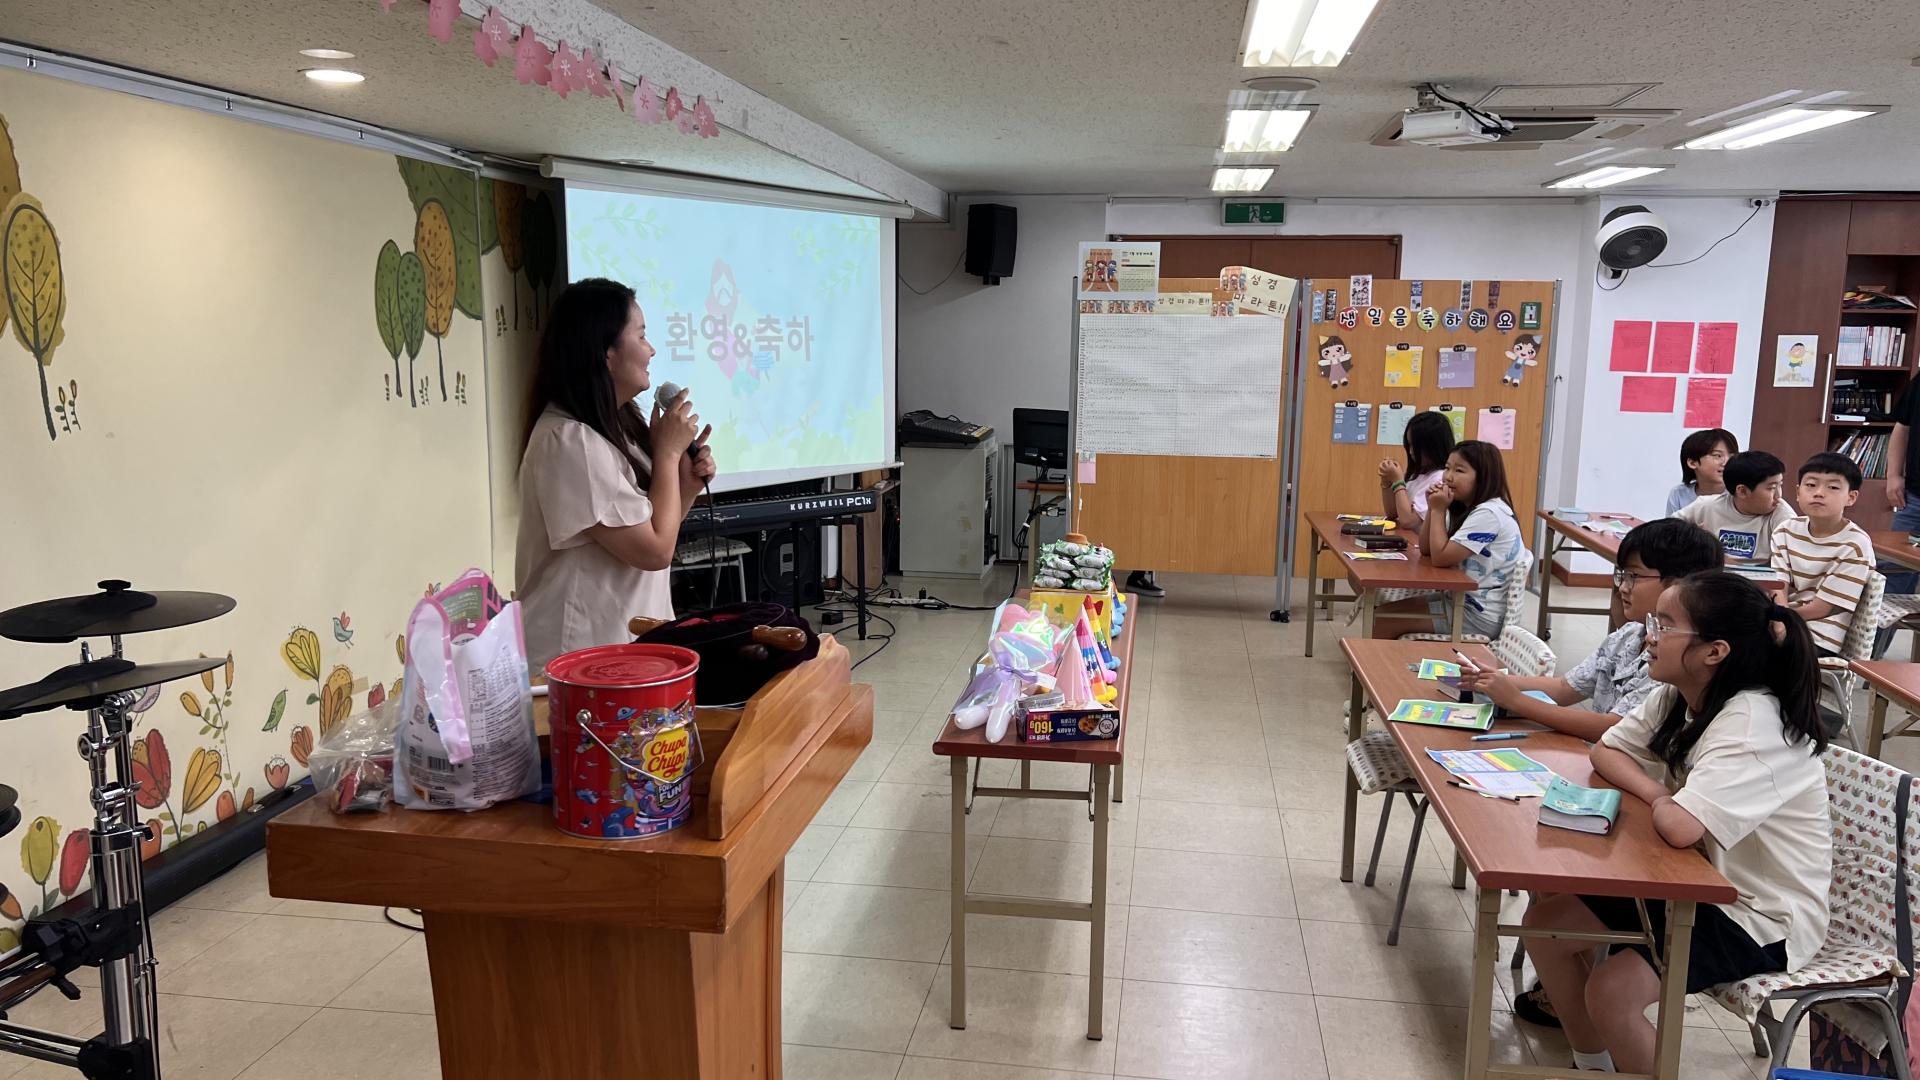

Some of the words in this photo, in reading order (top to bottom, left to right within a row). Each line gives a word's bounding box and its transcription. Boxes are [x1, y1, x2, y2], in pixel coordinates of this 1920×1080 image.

[1251, 274, 1278, 290] 성경
[1233, 292, 1287, 314] 마라톤!!
[665, 312, 814, 362] 환영&축하
[790, 499, 843, 511] KURZWEIL
[1029, 720, 1054, 734] 160g
[651, 737, 687, 756] Chupa
[647, 751, 686, 777] Chups
[659, 784, 682, 802] FUN
